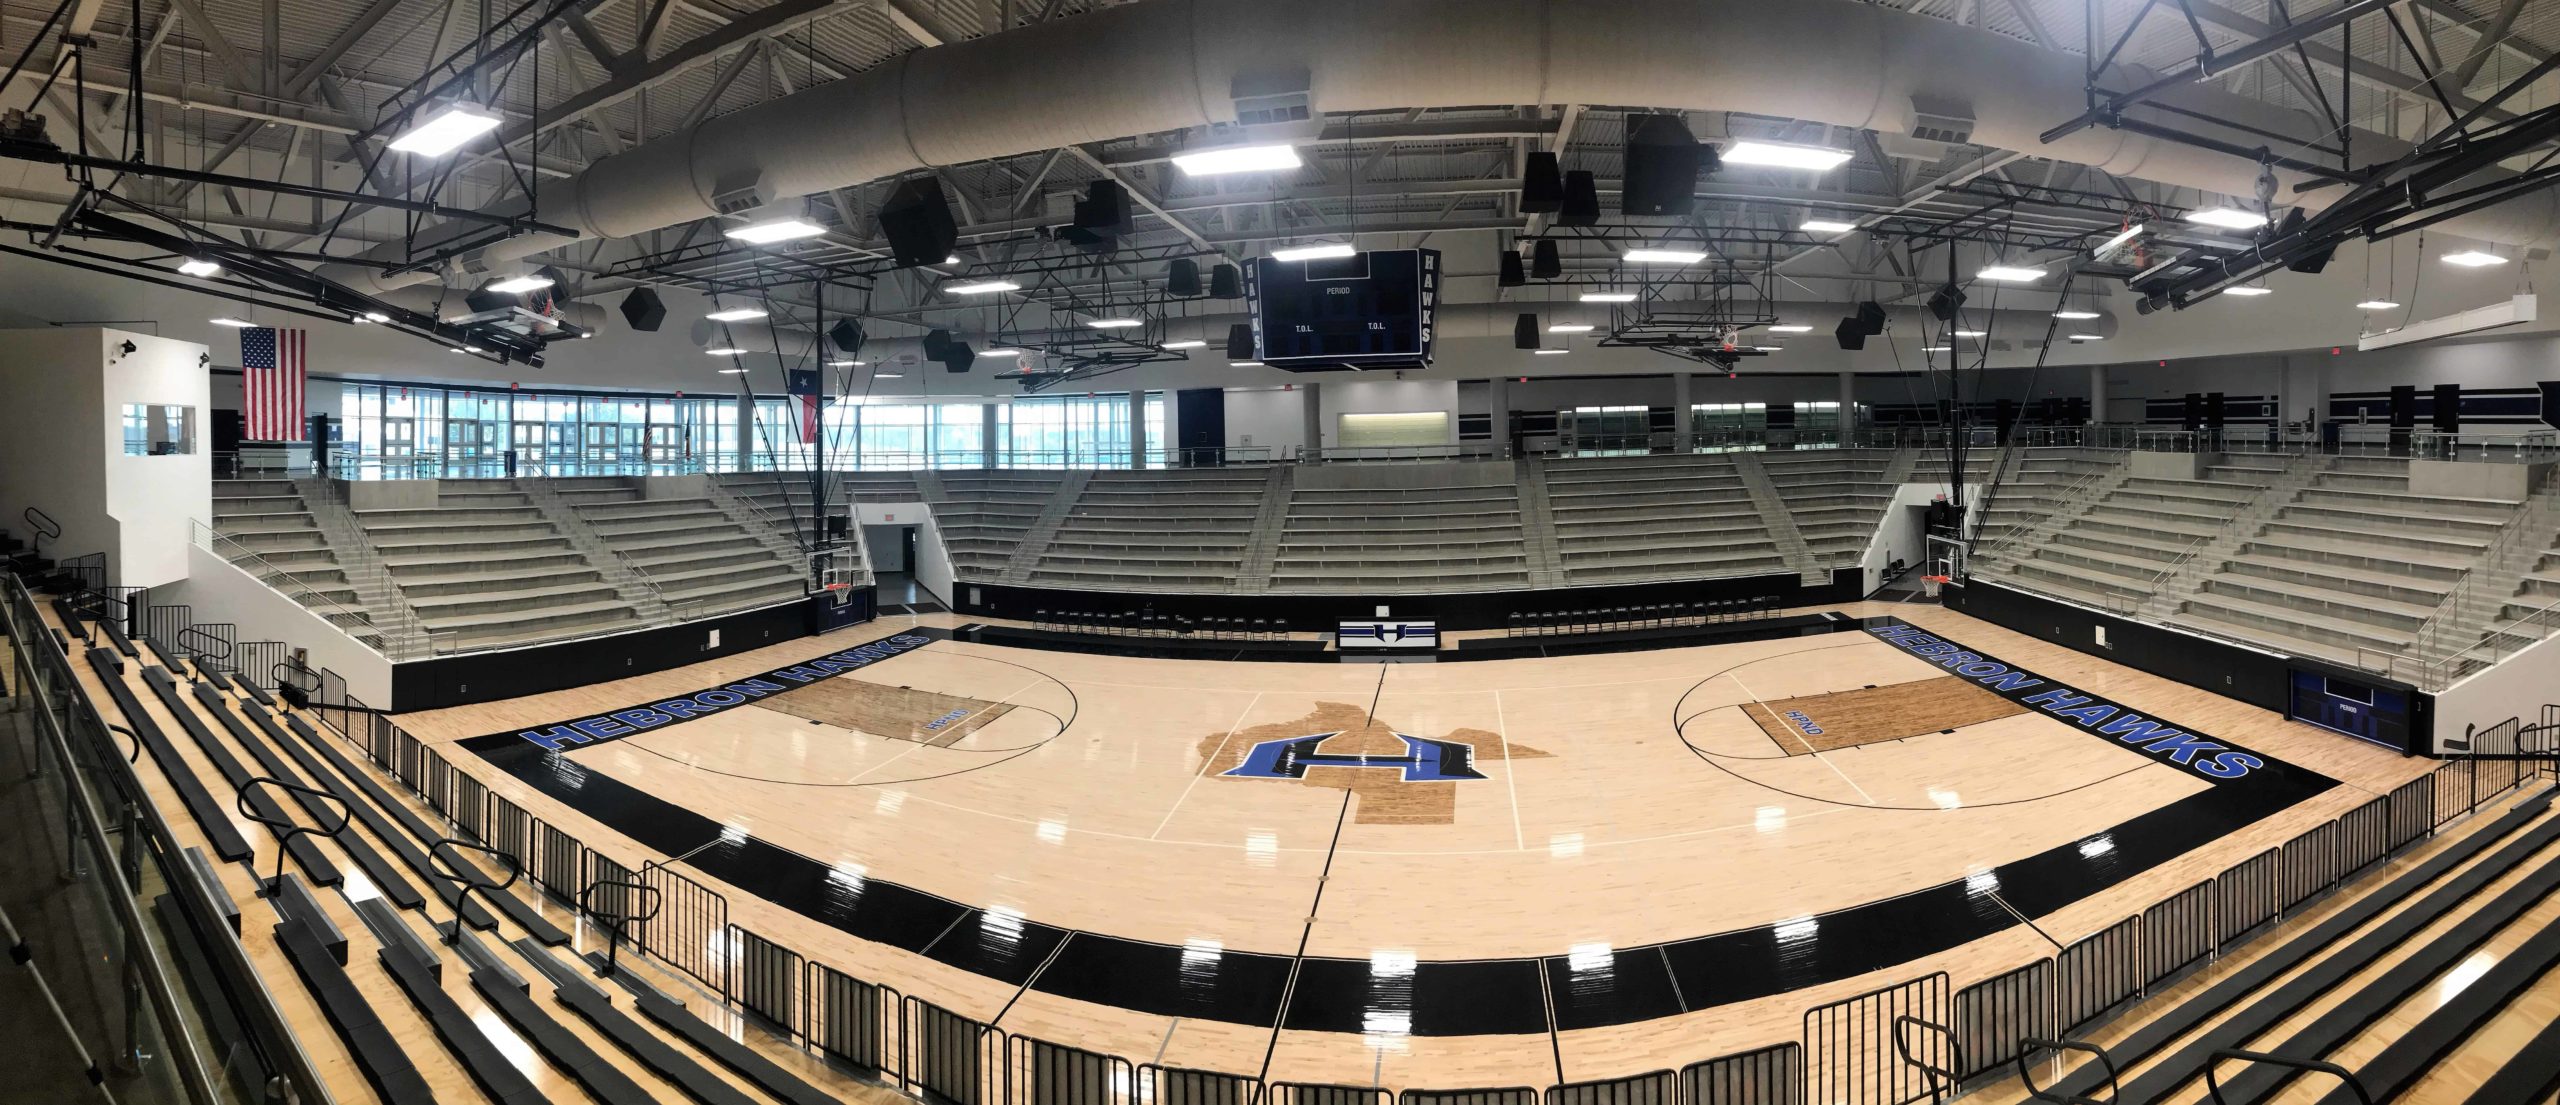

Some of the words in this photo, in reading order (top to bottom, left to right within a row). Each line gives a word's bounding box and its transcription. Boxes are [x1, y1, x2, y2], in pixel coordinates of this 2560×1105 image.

[1327, 287, 1350, 295] PERIOD
[1422, 255, 1434, 342] HAWKS
[1247, 264, 1260, 349] HAWKS
[1295, 324, 1314, 333] T.O.L.
[1367, 322, 1386, 330] T.O.L.
[518, 679, 786, 751] HEBRON
[772, 634, 930, 683] HAWKS
[1869, 624, 2045, 692] HEBRON
[2021, 688, 2264, 779] HAWKS
[2340, 704, 2357, 713] PERIOD
[1783, 710, 1824, 736] HPND
